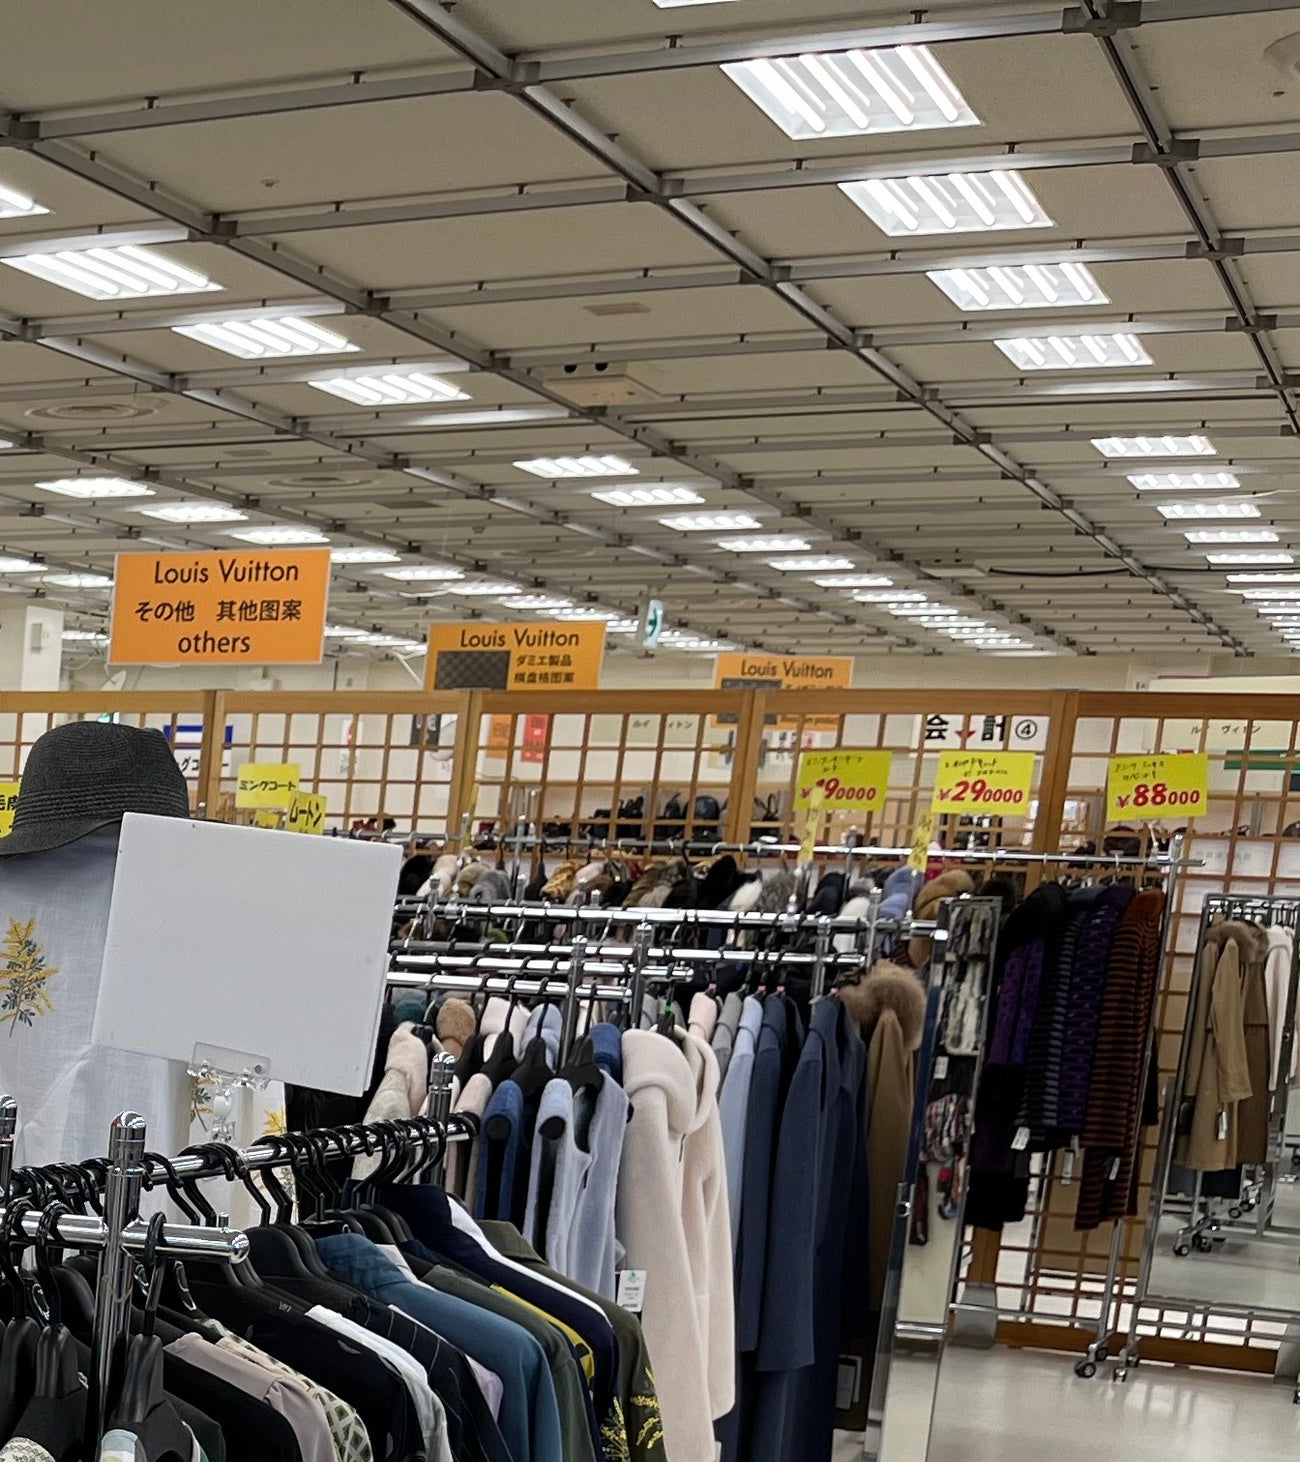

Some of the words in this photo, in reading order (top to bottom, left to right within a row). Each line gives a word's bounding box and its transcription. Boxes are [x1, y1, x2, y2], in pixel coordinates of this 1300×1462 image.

[154, 560, 209, 584] Louis
[218, 558, 299, 583] Vuitton
[135, 601, 195, 622] その他
[216, 600, 302, 622] 其他图案
[177, 630, 251, 654] others
[460, 629, 506, 648] Louis
[513, 627, 580, 647] Vuitton
[740, 659, 777, 677] Louis
[782, 660, 833, 679] Vuitton
[238, 779, 297, 792] ミンクコート
[938, 778, 1024, 805] ¥290000
[1117, 782, 1201, 809] ¥88000
